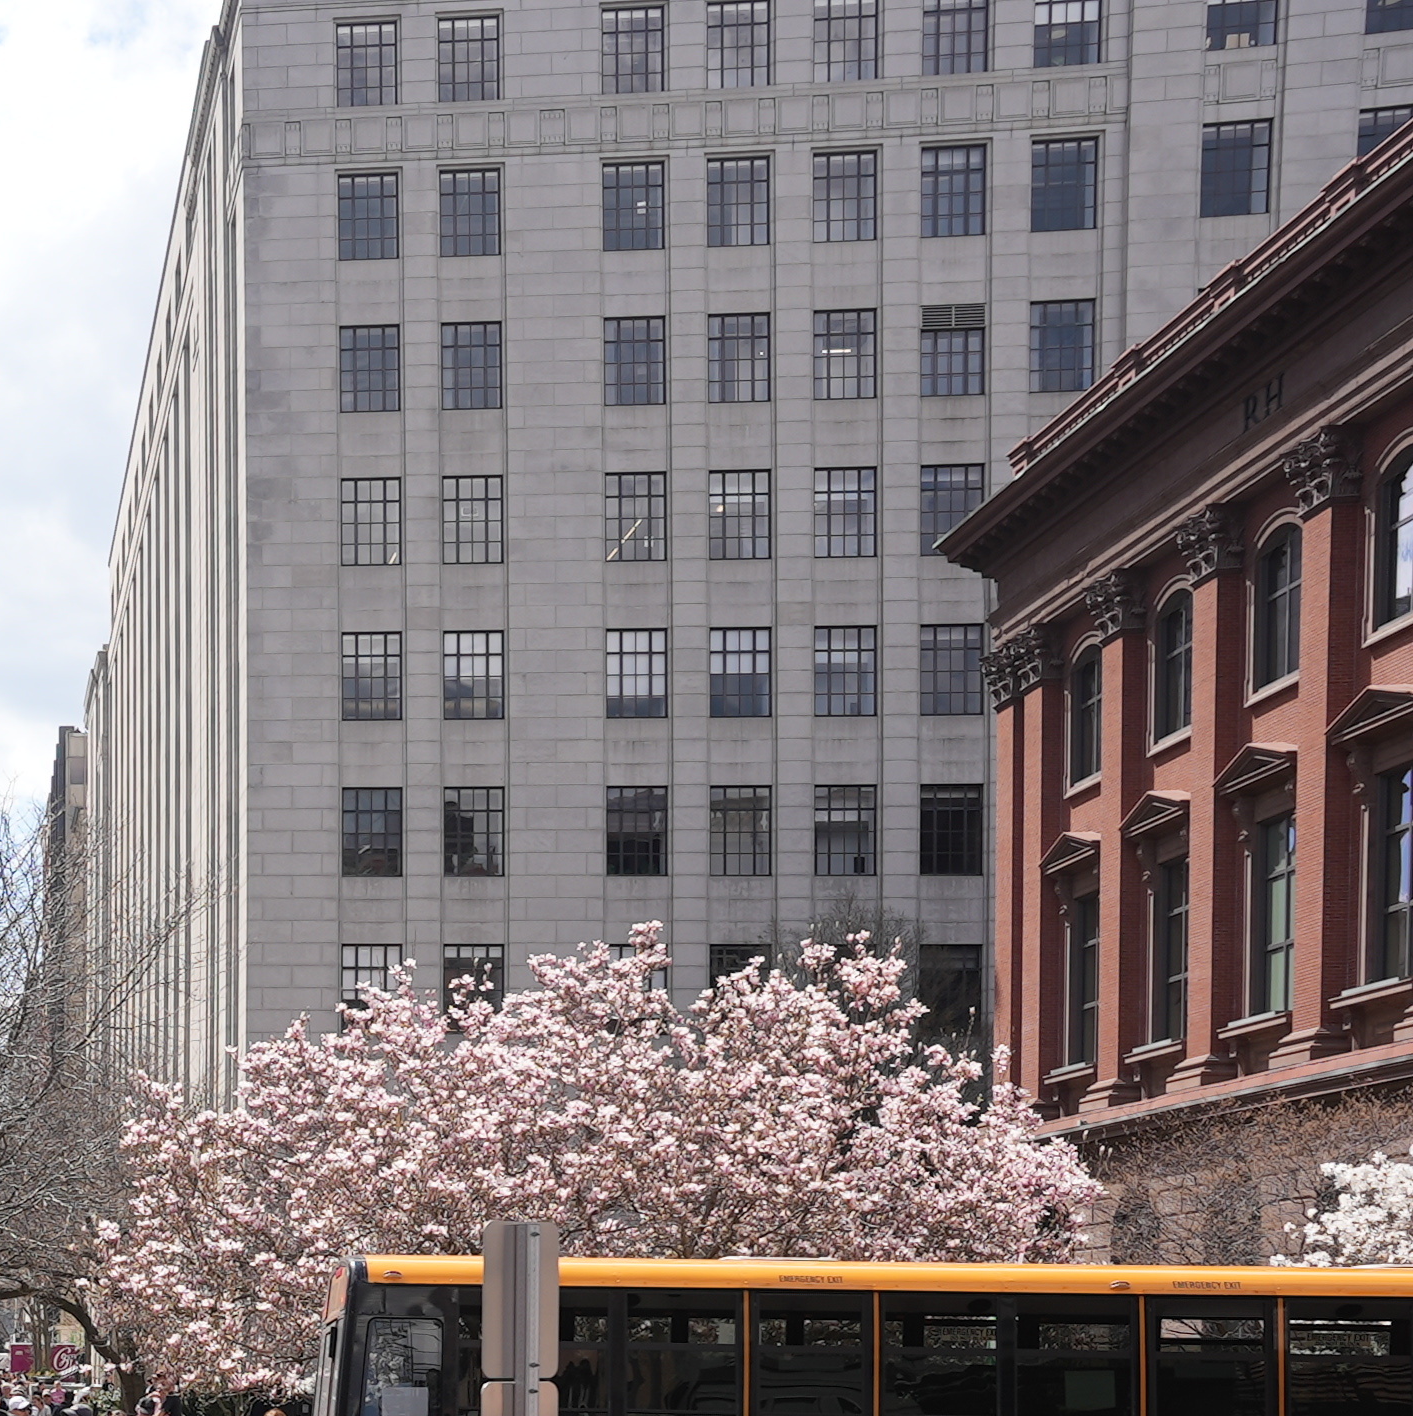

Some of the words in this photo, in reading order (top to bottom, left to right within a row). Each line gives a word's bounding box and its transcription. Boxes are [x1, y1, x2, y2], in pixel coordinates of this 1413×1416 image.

[779, 1274, 825, 1284] EMERGENCY
[827, 1276, 843, 1284] EXIT
[1173, 1281, 1221, 1289] EMERGENCY
[1224, 1281, 1241, 1290] EXIT
